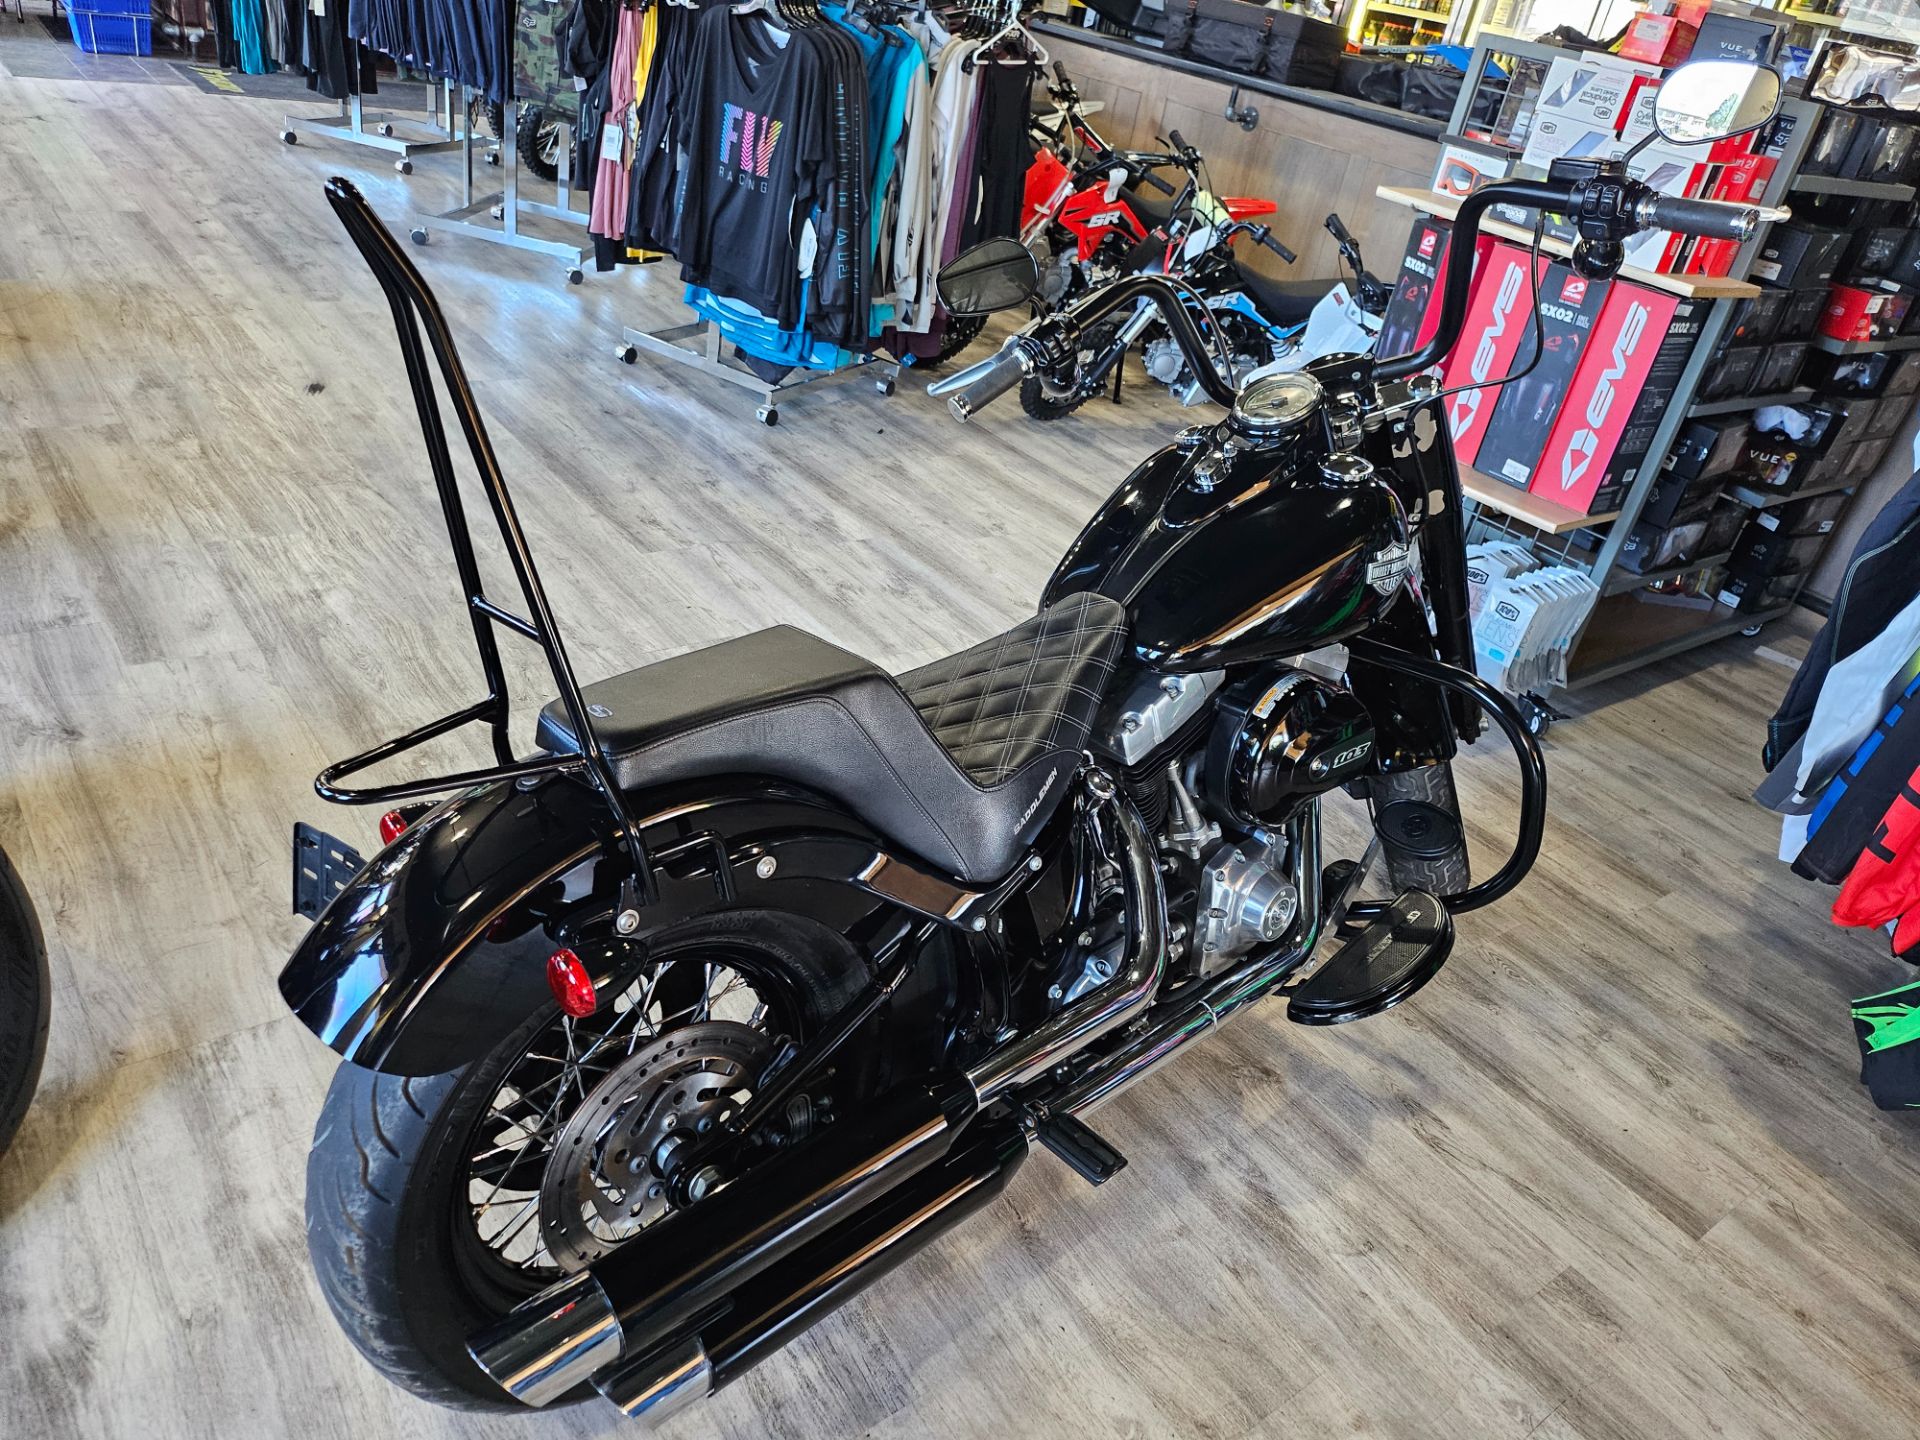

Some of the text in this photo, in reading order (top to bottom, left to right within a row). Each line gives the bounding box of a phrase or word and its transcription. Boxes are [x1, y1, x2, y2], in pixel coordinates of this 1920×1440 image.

[718, 165, 768, 194] RACNG
[1540, 302, 1574, 324] SX02
[1750, 449, 1780, 464] VUE
[1013, 766, 1058, 836] SADDLEMEN
